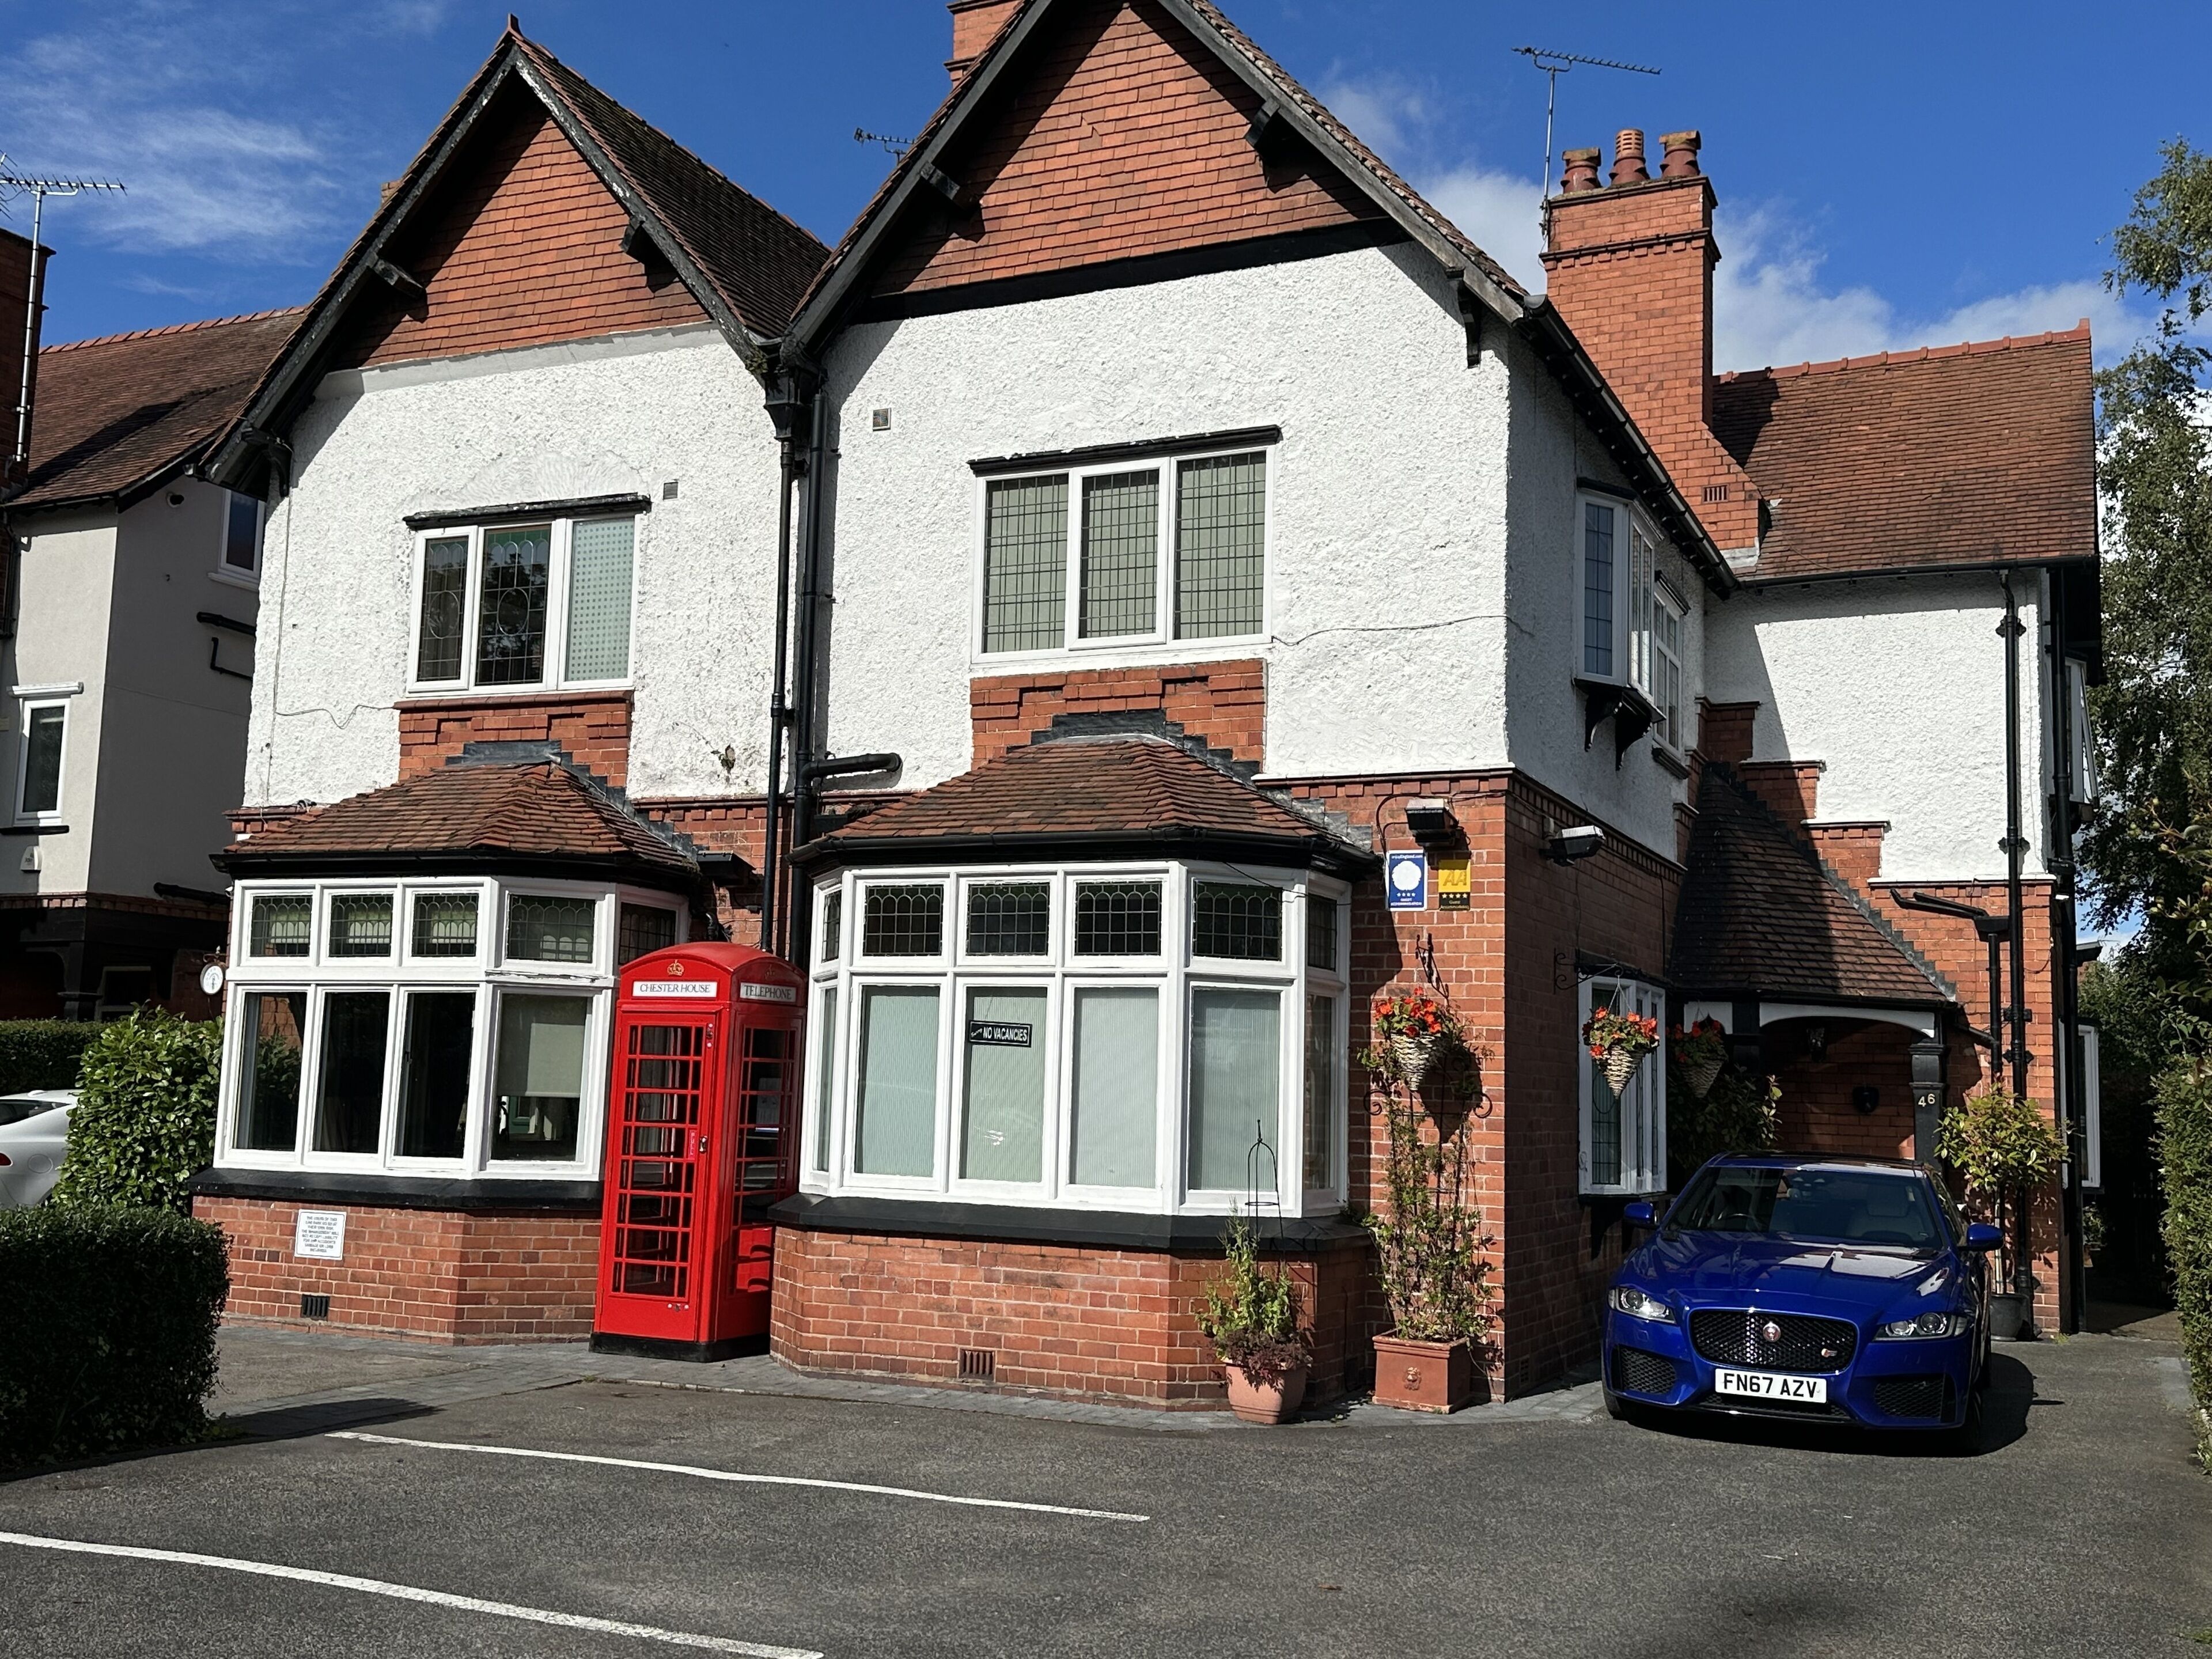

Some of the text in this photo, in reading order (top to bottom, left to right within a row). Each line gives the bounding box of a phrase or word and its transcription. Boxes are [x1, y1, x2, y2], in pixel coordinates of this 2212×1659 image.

[1443, 870, 1467, 886] AA
[640, 983, 711, 993] CHESTER HOUSE
[744, 984, 792, 1000] TELEPHONE
[983, 1027, 993, 1039] NO
[993, 1027, 1027, 1041] VACANCIES
[1918, 1093, 1936, 1107] 46
[1723, 1373, 1817, 1398] FN67 AZV
